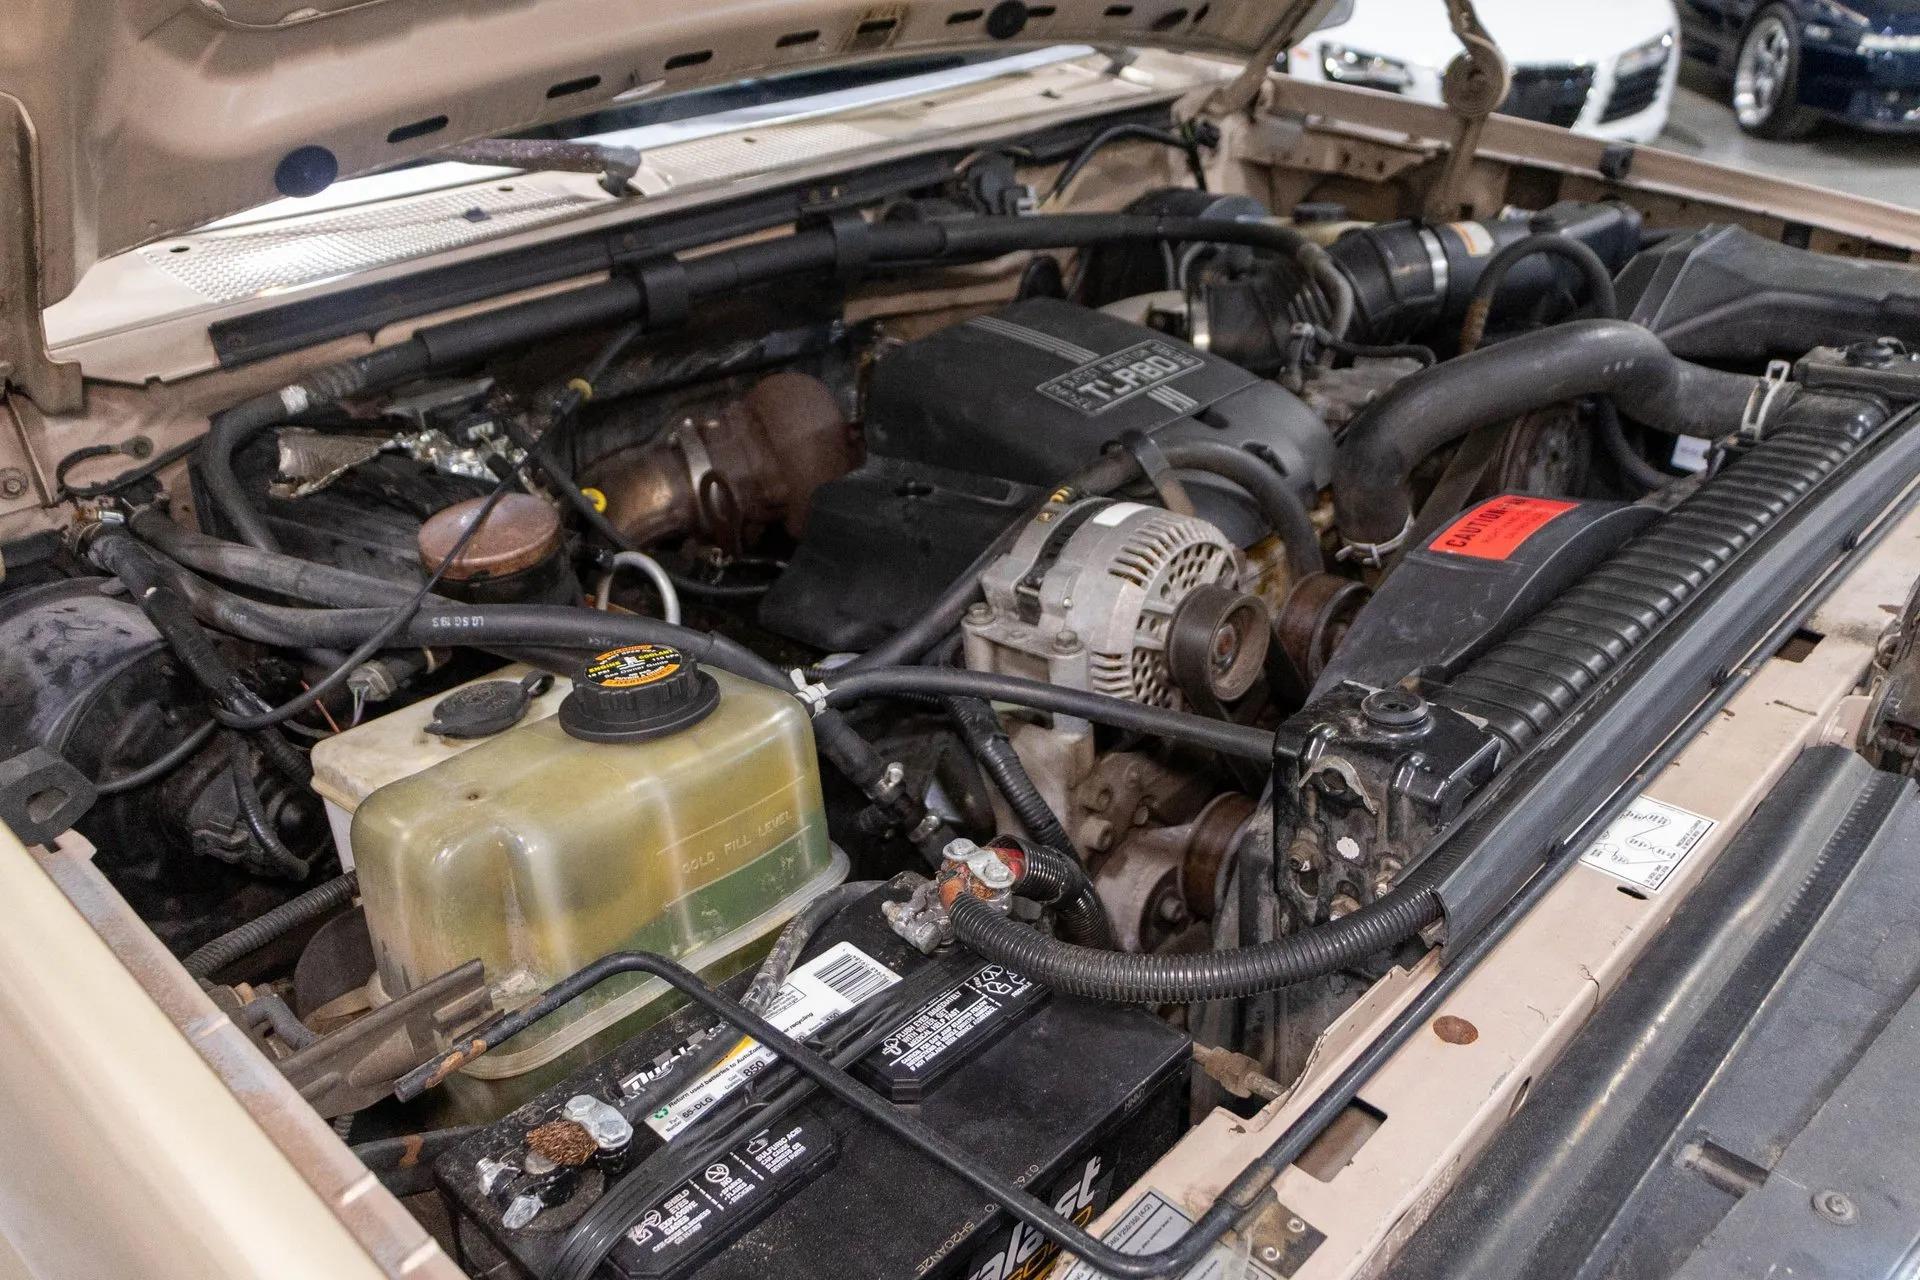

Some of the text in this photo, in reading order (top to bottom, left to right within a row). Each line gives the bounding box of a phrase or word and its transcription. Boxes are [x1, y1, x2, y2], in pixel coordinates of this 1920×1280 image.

[588, 661, 621, 673] ENGINE
[639, 649, 674, 660] COOLANT
[620, 665, 645, 675] Owner
[681, 811, 793, 874] COLD FILL LEVEL
[790, 1011, 815, 1031] recycling
[897, 1024, 916, 1040] FLUSH
[913, 1014, 930, 1027] EYES
[928, 990, 962, 1017] IMMEDIATELY
[935, 1009, 950, 1020] GET
[907, 1028, 933, 1048] MEDICAL
[931, 1018, 946, 1033] HELP
[668, 1092, 690, 1109] Return
[689, 1082, 705, 1095] used
[704, 1066, 731, 1086] batteries
[681, 1096, 714, 1119] 65-DLG
[743, 1060, 766, 1078] 850
[755, 1126, 803, 1162] SULFURIC ACID
[720, 1177, 733, 1187] NO
[663, 1189, 690, 1210] SHIELD
[669, 1198, 691, 1215] EYES
[658, 1200, 698, 1232] EXPLOSIVE
[664, 1215, 691, 1236] GASES
[967, 1155, 1102, 1280] alast
